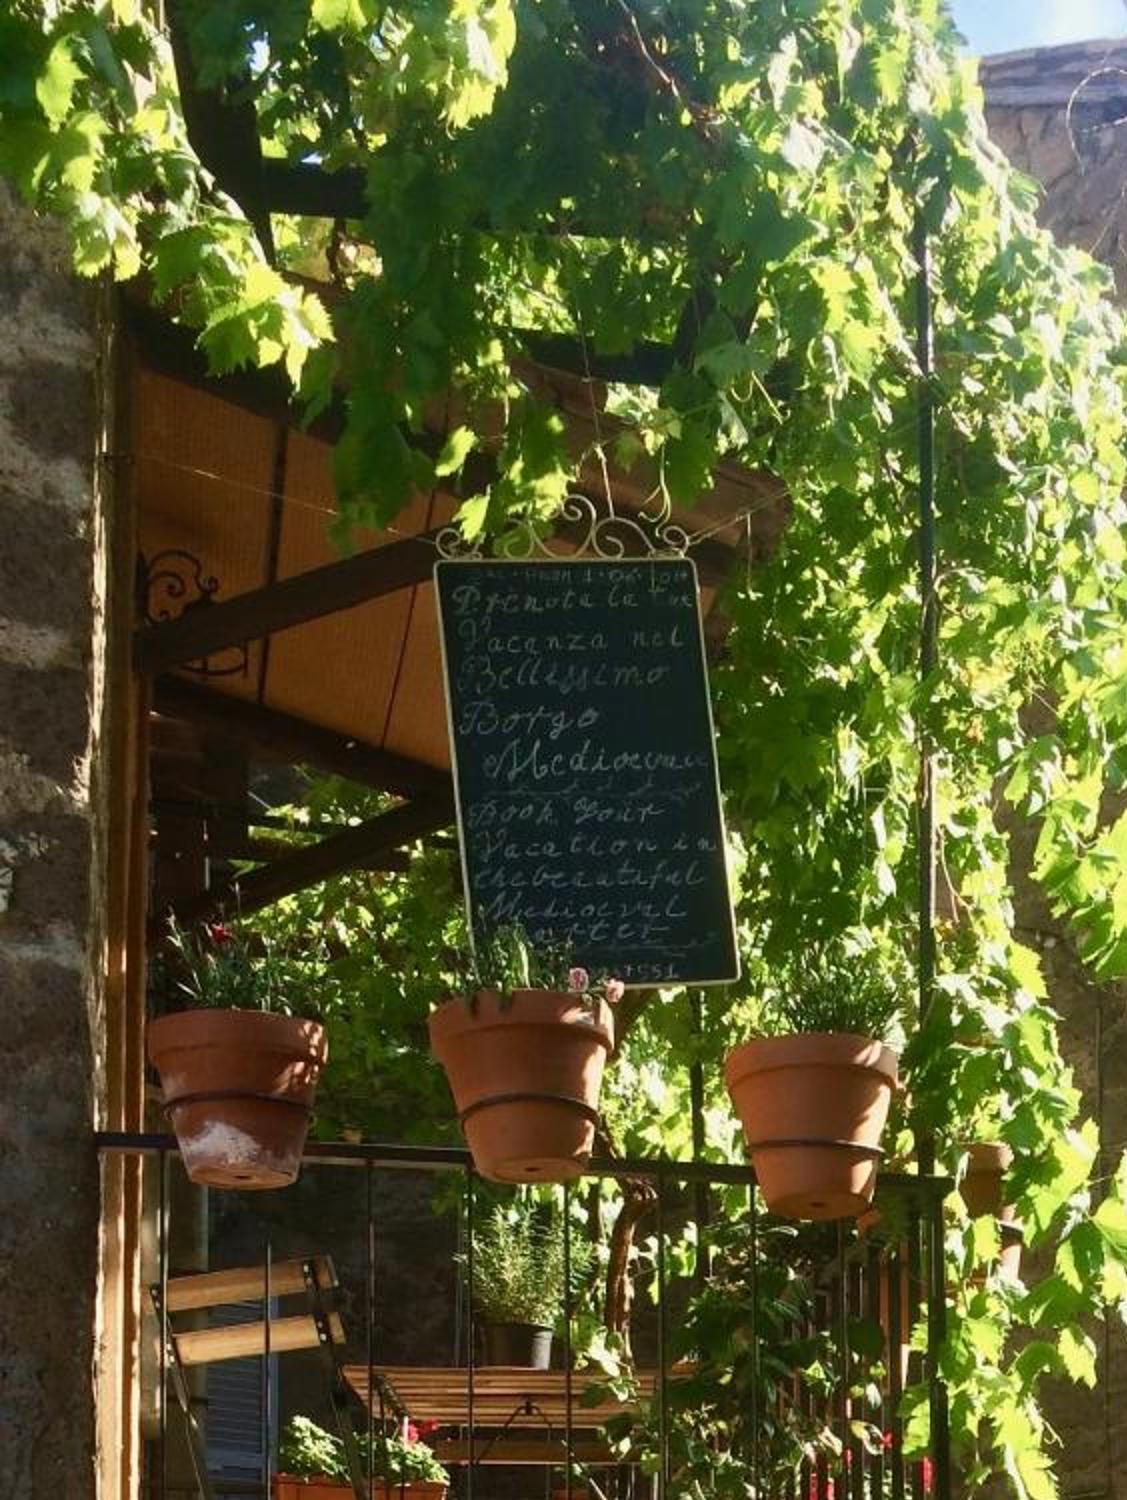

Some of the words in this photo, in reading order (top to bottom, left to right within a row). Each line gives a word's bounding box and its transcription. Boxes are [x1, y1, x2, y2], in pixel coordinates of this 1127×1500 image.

[452, 584, 593, 614] Prenota
[457, 615, 608, 653] Vacanza
[457, 655, 670, 694] Bellissimo
[459, 701, 599, 739] Borgo
[468, 799, 555, 829] Book
[476, 828, 657, 862] Vacation
